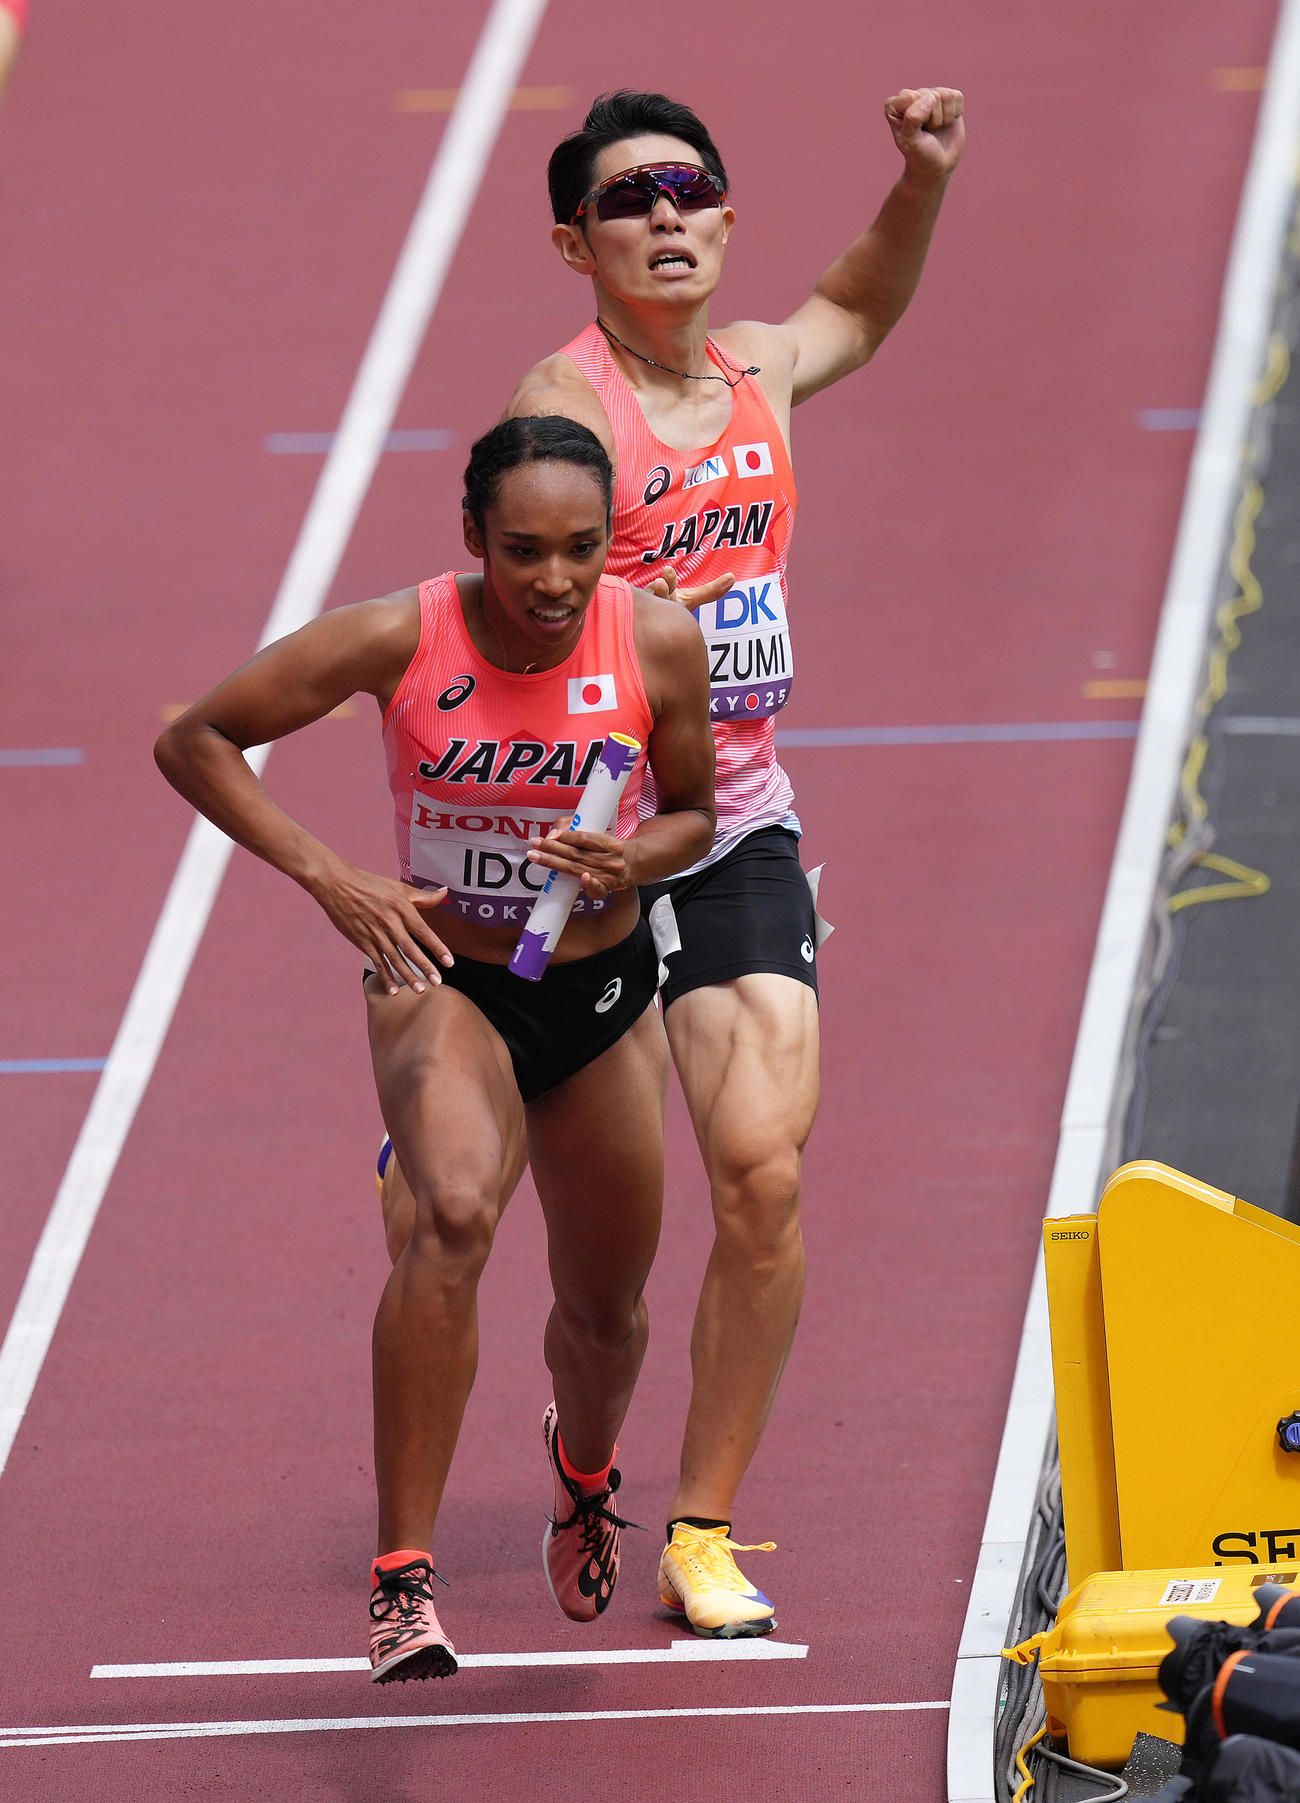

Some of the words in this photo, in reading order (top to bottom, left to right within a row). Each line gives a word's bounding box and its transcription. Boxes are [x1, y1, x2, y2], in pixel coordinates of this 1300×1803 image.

[683, 458, 720, 488] ACN
[642, 502, 773, 565] JAPAN
[692, 582, 778, 630] DK
[705, 633, 785, 682] ZUMI
[513, 943, 525, 963] 1
[1051, 1231, 1090, 1241] SEIKO
